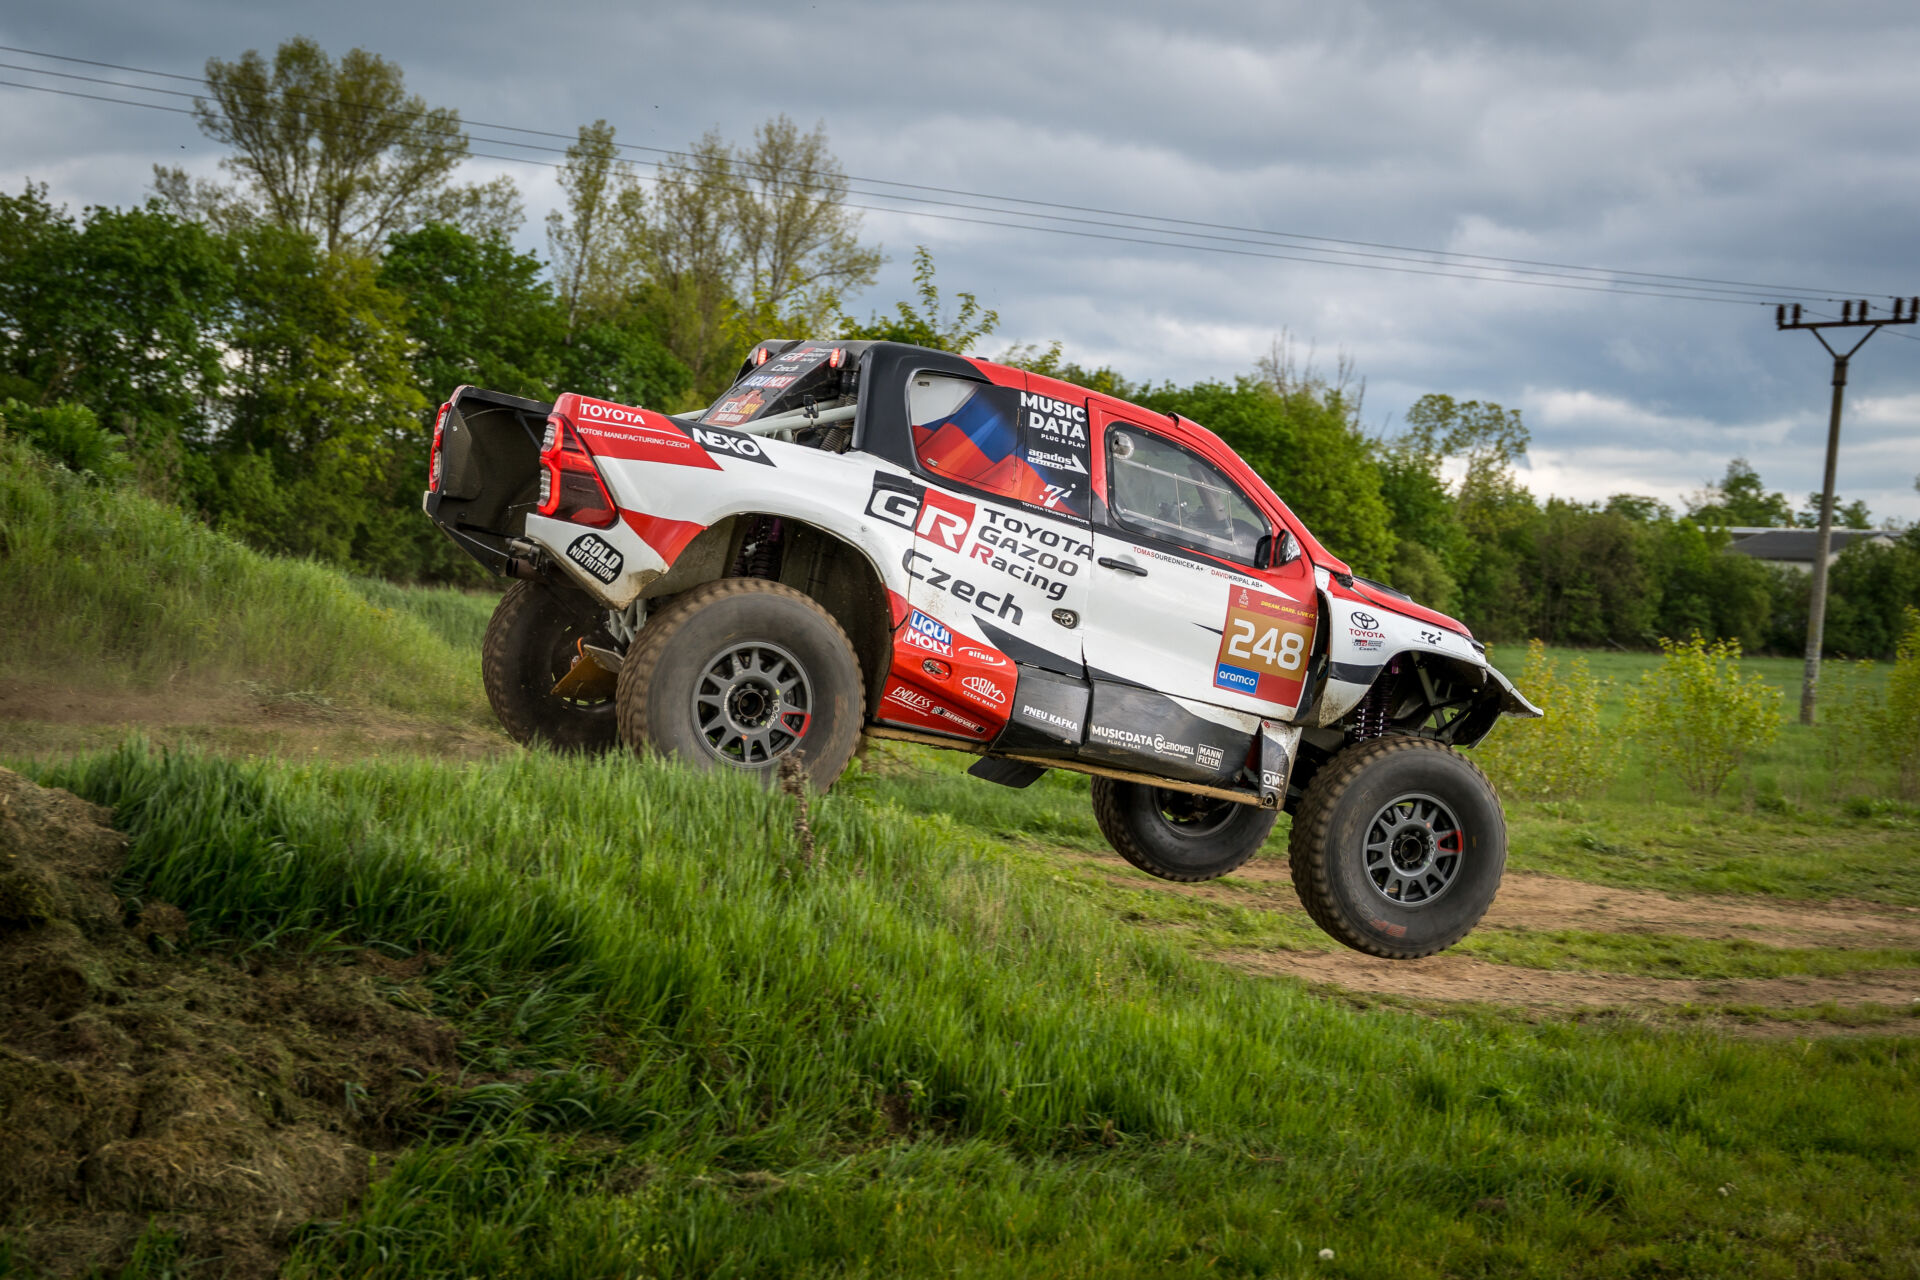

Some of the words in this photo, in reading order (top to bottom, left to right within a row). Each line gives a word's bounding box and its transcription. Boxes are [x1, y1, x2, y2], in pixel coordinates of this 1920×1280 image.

[581, 403, 645, 425] TOYOTA
[1020, 391, 1086, 422] MUSIC
[576, 426, 603, 436] MOTOR
[603, 431, 665, 446] MANUFACTURING
[665, 439, 690, 449] CZECH
[1029, 411, 1086, 441] DATA
[692, 428, 761, 457] NEXO
[1041, 434, 1059, 442] PLUG
[1068, 440, 1086, 449] PLAY
[1028, 449, 1072, 465] agados
[870, 489, 968, 549] GR
[983, 508, 1095, 561] TOYOTA
[569, 545, 616, 582] NUTRITION
[580, 535, 621, 570] GOLD
[978, 525, 1079, 577] GAZOO
[969, 543, 1068, 601] Racing
[902, 548, 1024, 627] Czech
[911, 611, 951, 645] LIQUI
[1349, 628, 1386, 639] TOYOTA
[906, 628, 951, 656] MOLY
[1228, 618, 1305, 671] 248
[970, 676, 1003, 699] PRIM
[1219, 670, 1256, 687] aramco
[891, 686, 935, 708] ENDLESS
[963, 690, 981, 703] CZECH
[981, 698, 998, 710] MADE
[944, 712, 977, 730] RENOVAK
[1023, 705, 1048, 720] PNEU
[1049, 713, 1078, 731] KAFKA
[1091, 725, 1153, 747] MUSICDATA
[1197, 756, 1220, 768] FILTER
[1199, 746, 1222, 759] MANN
